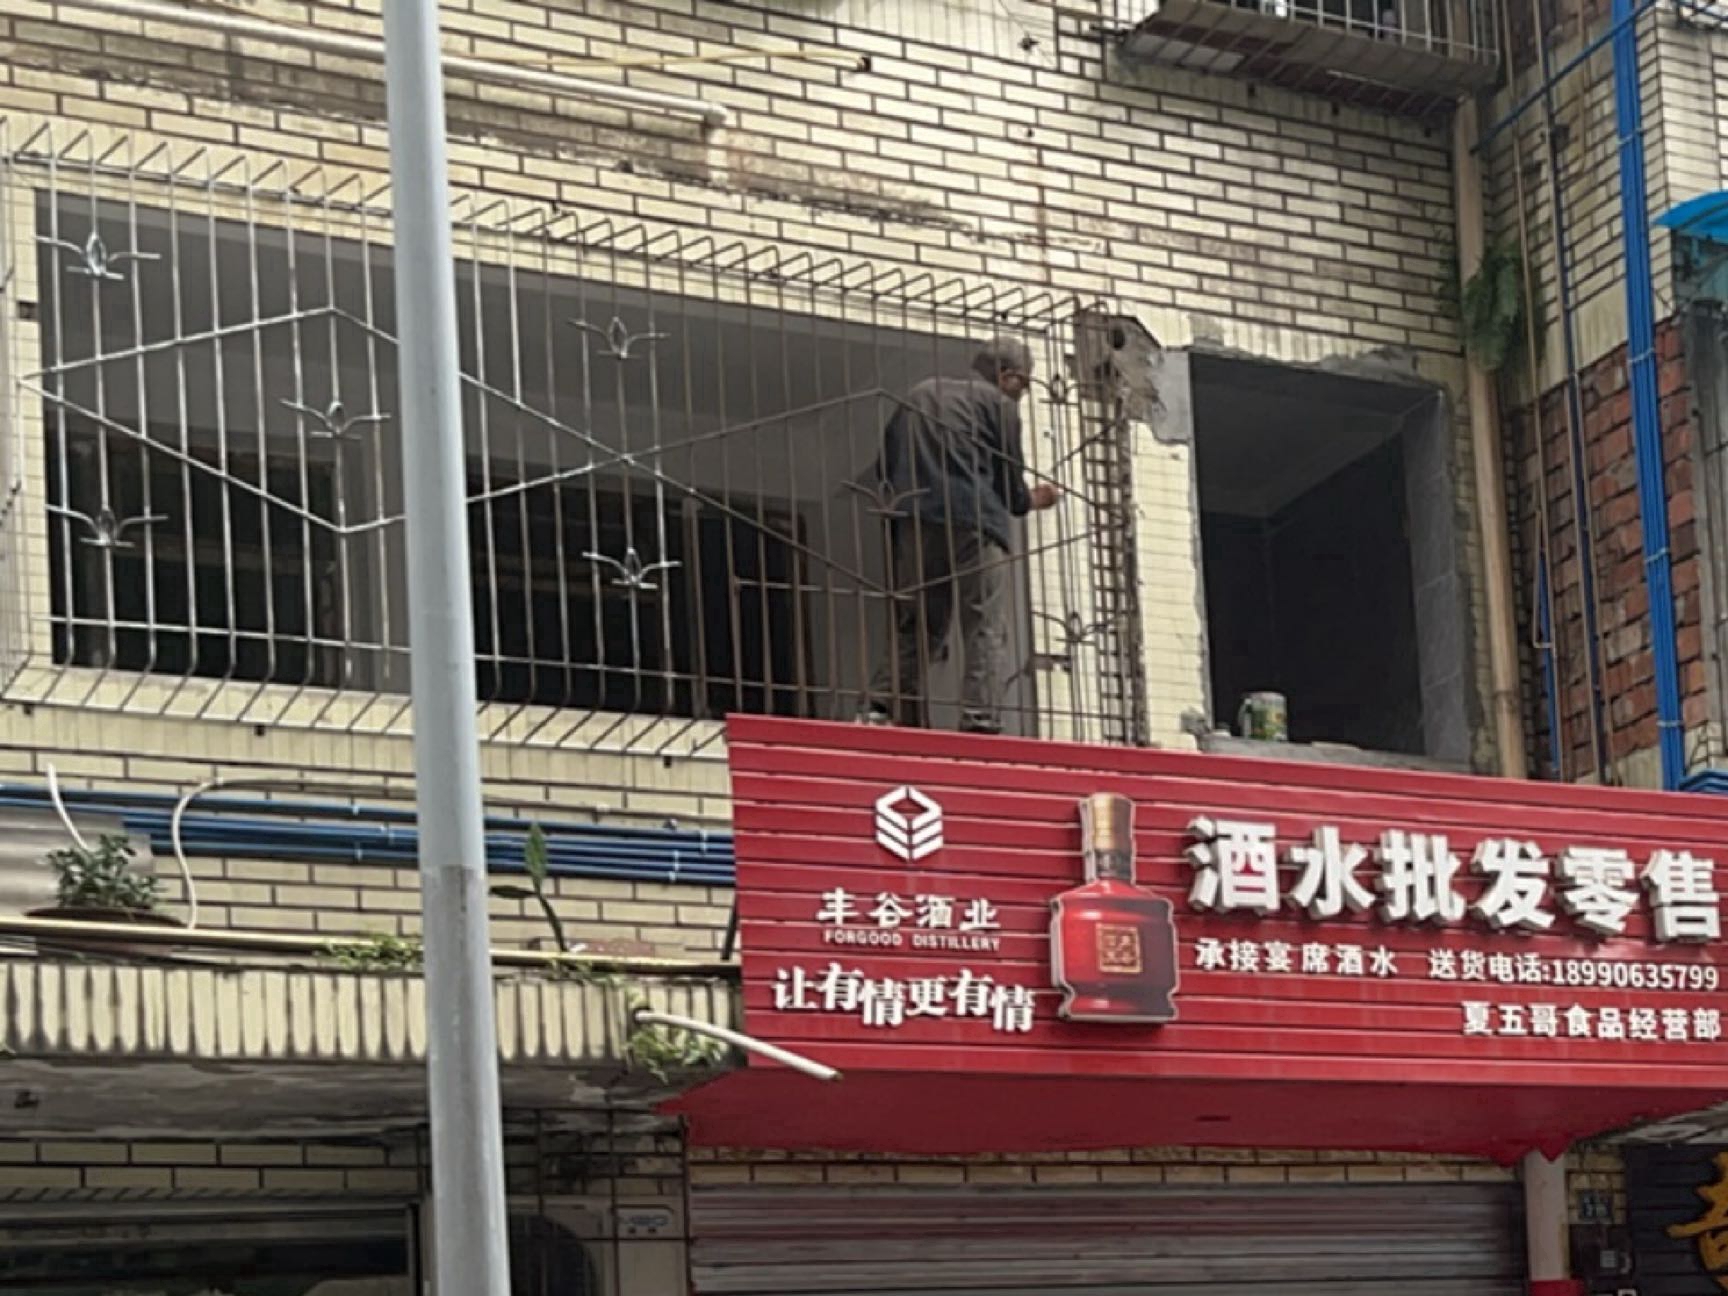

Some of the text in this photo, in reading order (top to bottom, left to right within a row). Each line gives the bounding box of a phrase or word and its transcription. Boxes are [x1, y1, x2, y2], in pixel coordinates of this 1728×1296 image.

[1186, 816, 1720, 942] 酒水批发零售
[816, 887, 1001, 931] 丰谷酒业
[823, 929, 1000, 951] FORGOOD DISTILLERY
[1195, 937, 1719, 991] 承接宴席酒水 送货电话:18990635799
[774, 962, 1036, 1033] 让有情更有情
[1461, 1001, 1721, 1040] 夏五哥食品经营部
